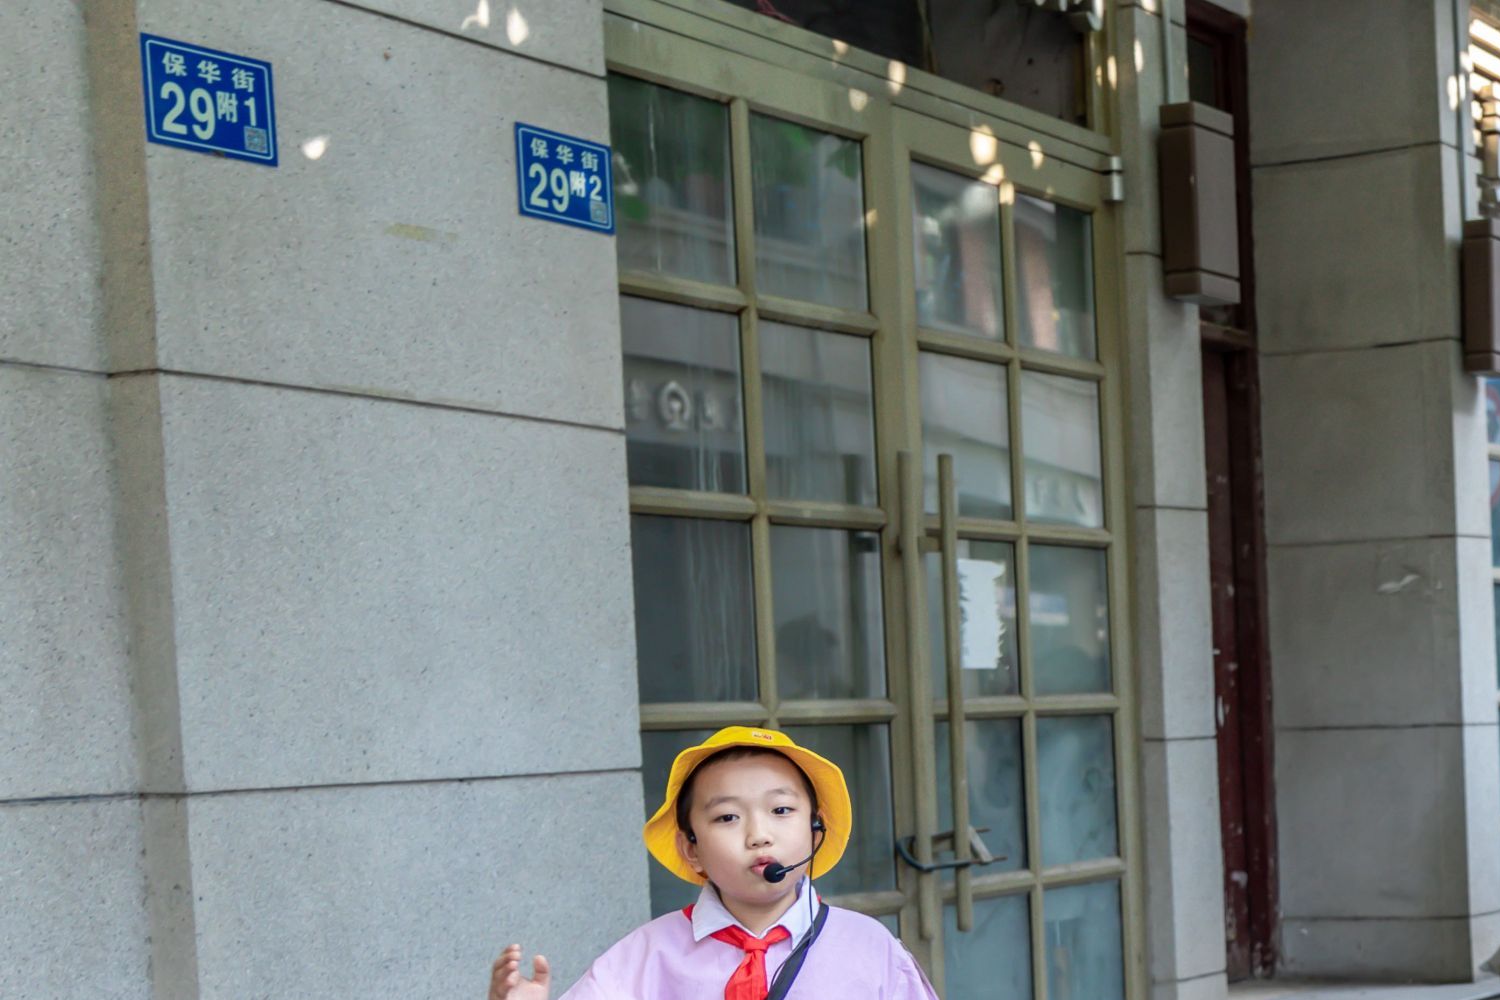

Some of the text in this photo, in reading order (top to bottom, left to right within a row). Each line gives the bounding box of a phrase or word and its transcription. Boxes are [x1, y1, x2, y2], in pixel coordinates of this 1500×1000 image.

[162, 51, 256, 92] 保华街
[530, 137, 599, 172] 保华街
